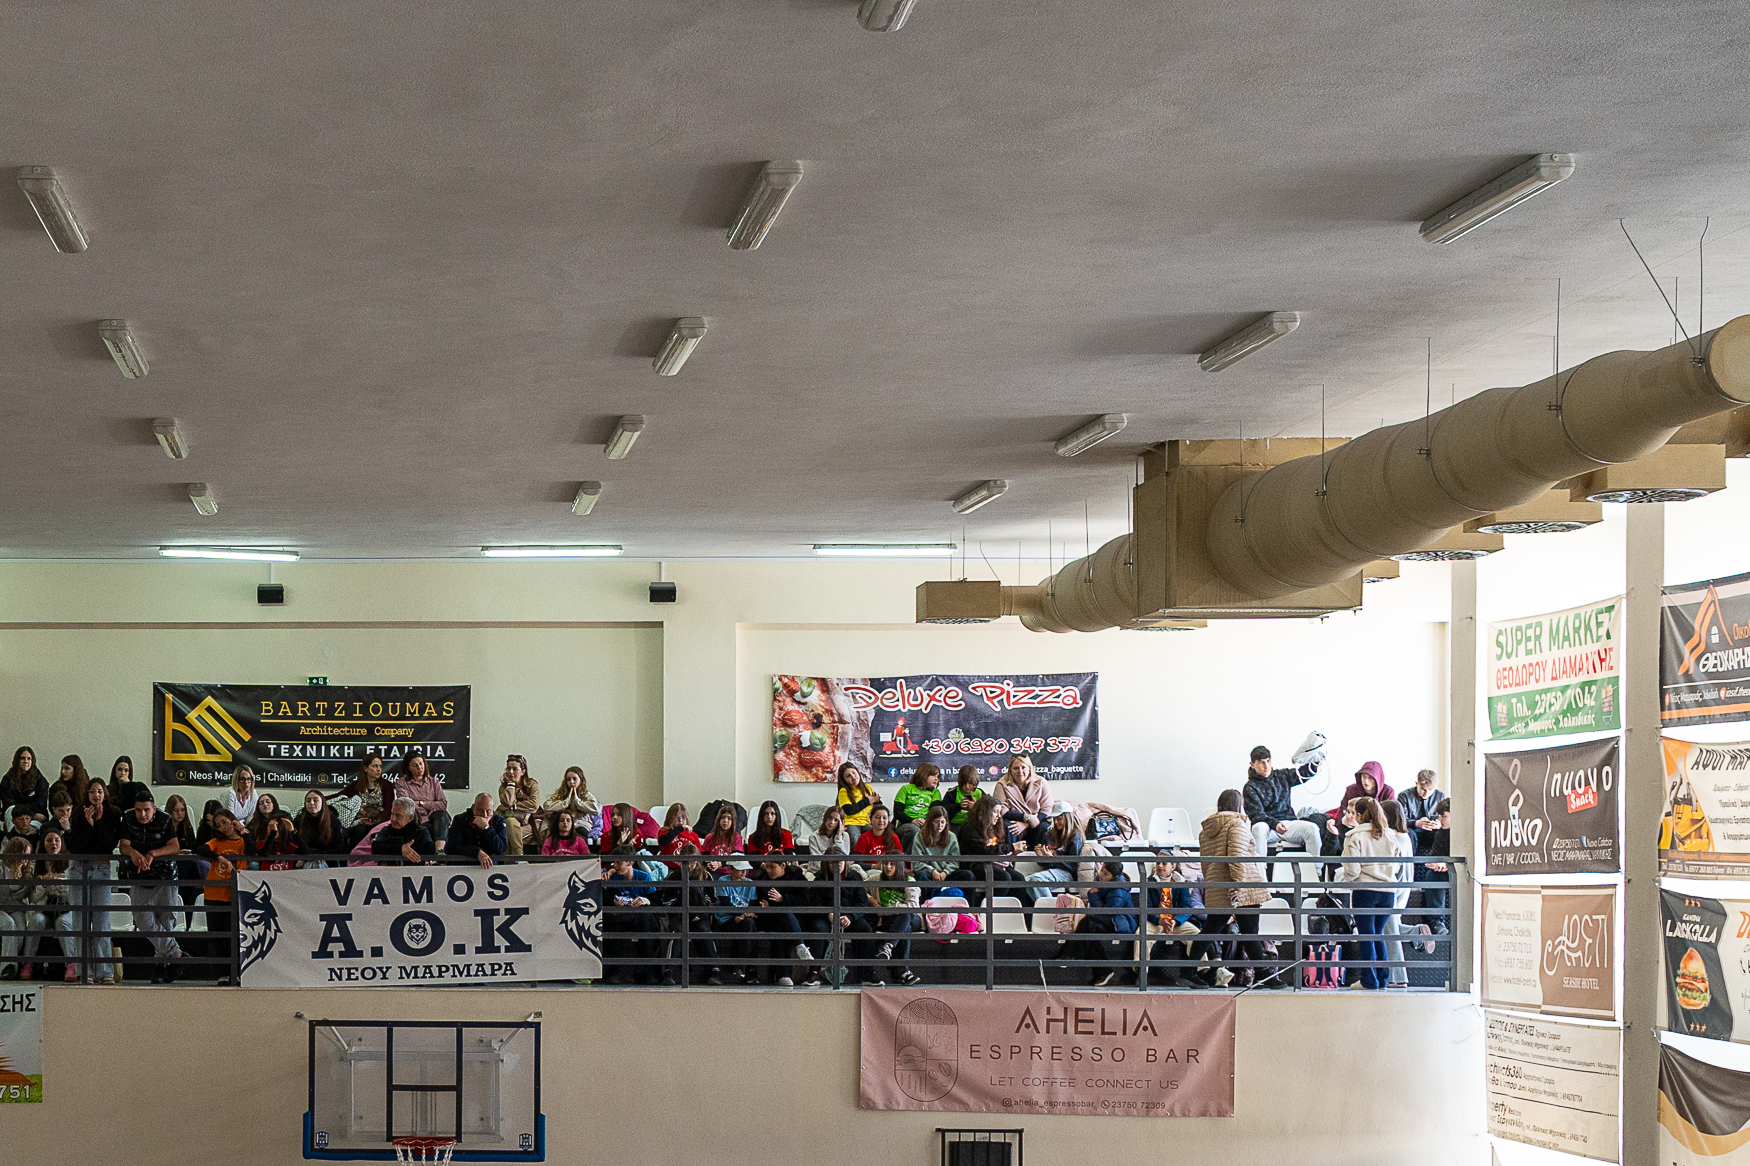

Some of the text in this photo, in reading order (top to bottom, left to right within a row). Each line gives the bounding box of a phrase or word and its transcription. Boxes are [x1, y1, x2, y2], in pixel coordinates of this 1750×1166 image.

[1496, 604, 1615, 661] SUPER MARKET
[1496, 659, 1548, 690] ΘΕΟΔΩΡΟΥ
[842, 679, 1082, 712] Deluxe Pizza
[260, 701, 454, 717] BARTZIOUMAS
[300, 726, 414, 737] Architecture Company
[268, 744, 354, 758] ΤΕΧΝΙΚΗ
[922, 736, 1084, 754] +30 6980 347 377
[189, 770, 212, 780] Neos
[268, 772, 312, 782] Chalkidiki
[1550, 766, 1612, 798] nuovo
[328, 873, 510, 906] VAMOS
[327, 962, 518, 982] ΝΕΟΥ ΜΑΡΜΑΡΑ
[1014, 1004, 1158, 1037] AHELIA
[970, 1044, 1200, 1064] ESPRESSO BAR
[990, 1076, 1179, 1090] LET COFFEE CONNECT US
[1014, 1099, 1095, 1108] ahelia_espressobar
